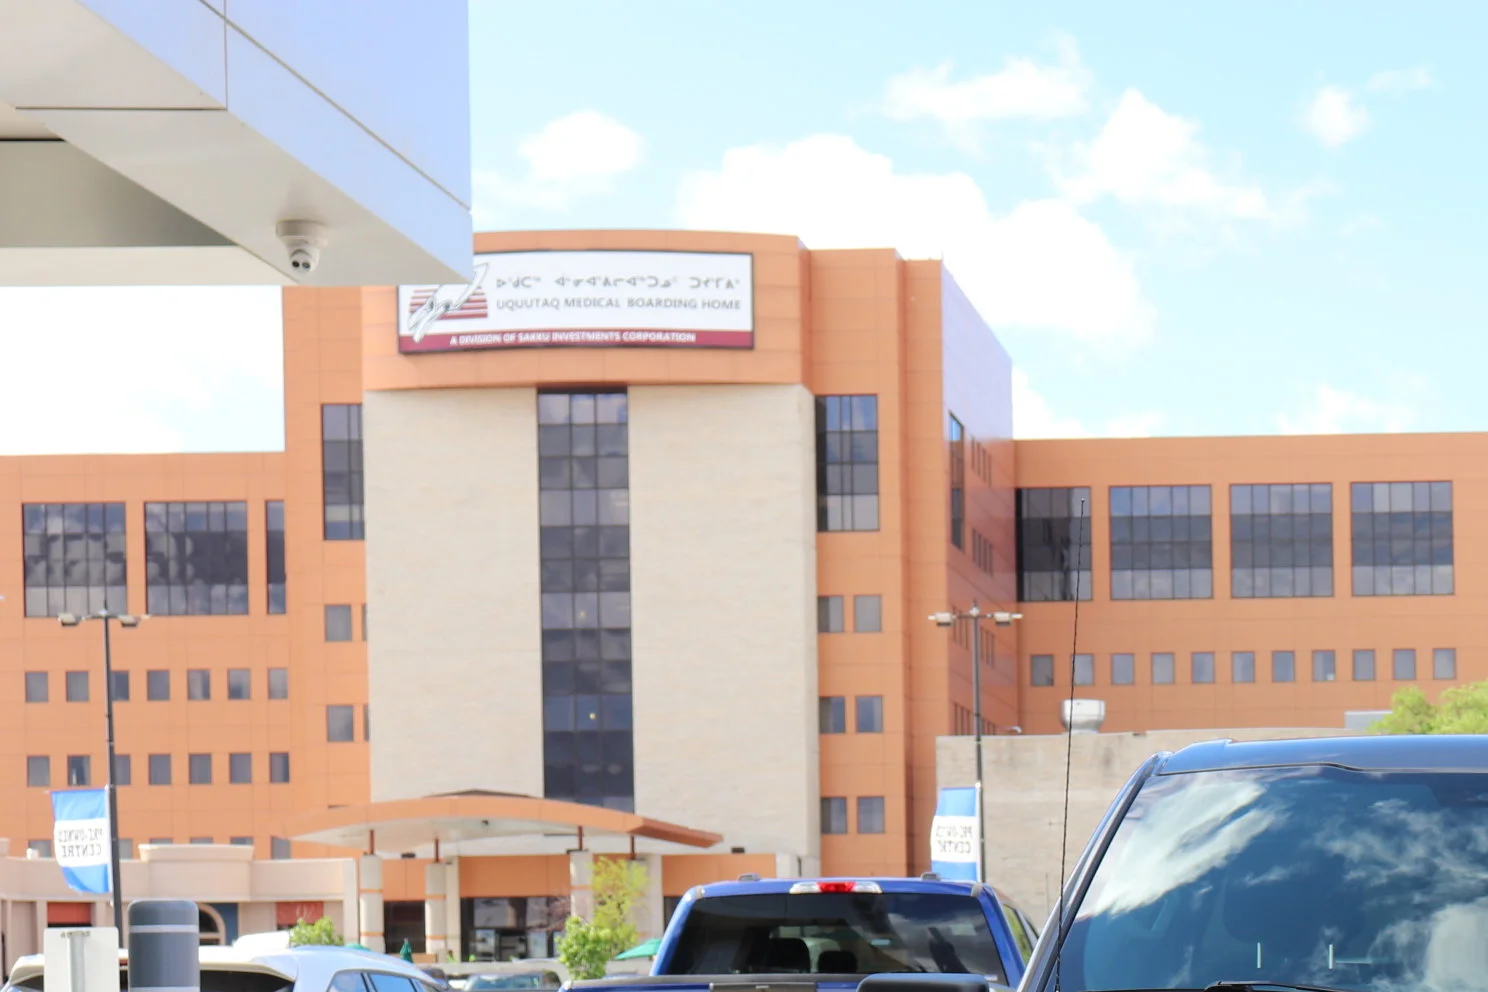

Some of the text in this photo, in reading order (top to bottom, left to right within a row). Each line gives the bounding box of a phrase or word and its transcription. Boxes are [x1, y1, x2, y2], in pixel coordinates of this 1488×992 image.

[496, 297, 741, 310] UQUUTAQ MEDICAL BOARDING HOME
[459, 334, 501, 345] DIVISION
[503, 333, 516, 343] OF
[551, 331, 620, 342] INVESTMENTS
[622, 331, 697, 342] CORPORATION
